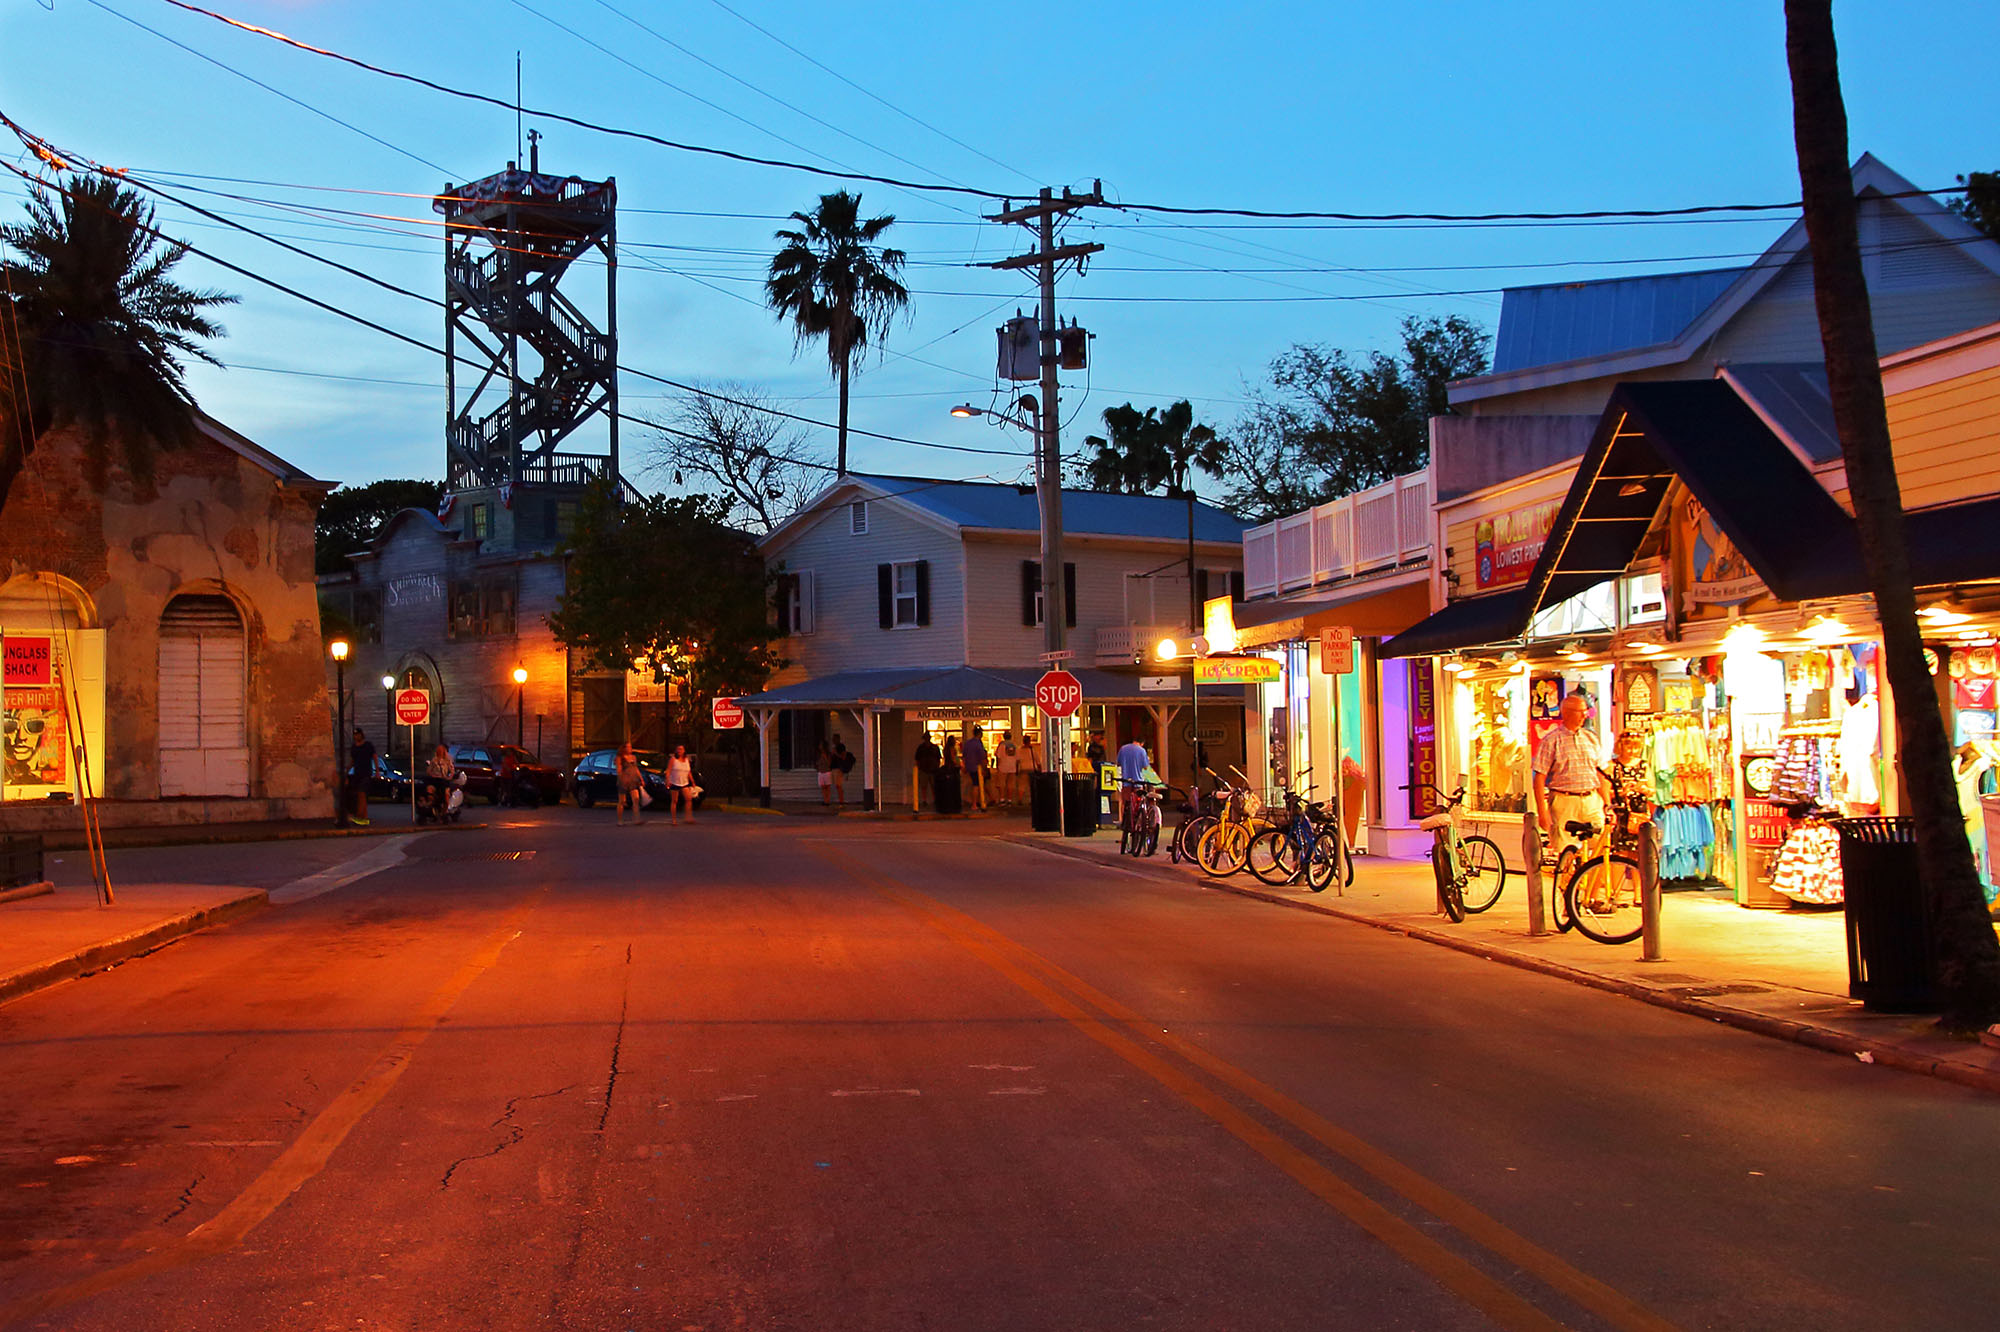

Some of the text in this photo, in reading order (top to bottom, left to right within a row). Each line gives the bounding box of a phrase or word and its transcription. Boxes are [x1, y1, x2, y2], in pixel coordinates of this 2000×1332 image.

[1496, 547, 1523, 568] LOWEST
[1330, 631, 1343, 641] NO
[1323, 641, 1350, 650] PARKING
[5, 664, 38, 675] SHACK
[1226, 664, 1270, 677] CREAM
[27, 693, 52, 706] HIDE
[1039, 686, 1078, 703] STOP
[932, 710, 960, 718] CENTER
[961, 709, 992, 718] GALLERY
[1419, 747, 1435, 813] TOURS
